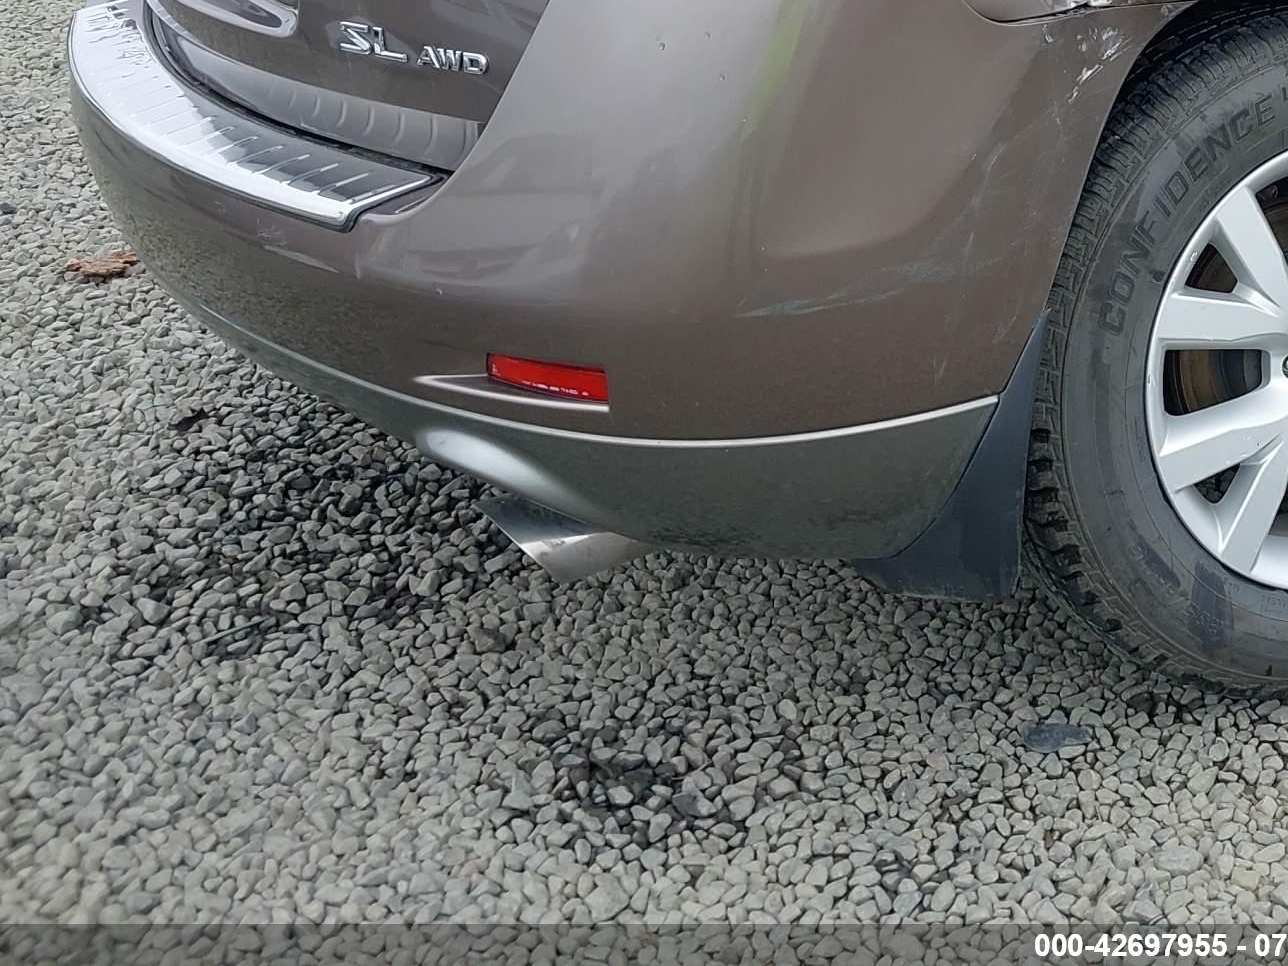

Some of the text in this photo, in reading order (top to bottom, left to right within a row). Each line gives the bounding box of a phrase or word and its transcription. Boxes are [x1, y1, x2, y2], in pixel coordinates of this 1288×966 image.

[339, 20, 490, 75] SL AWD
[1098, 94, 1277, 335] CONFIDENCE
